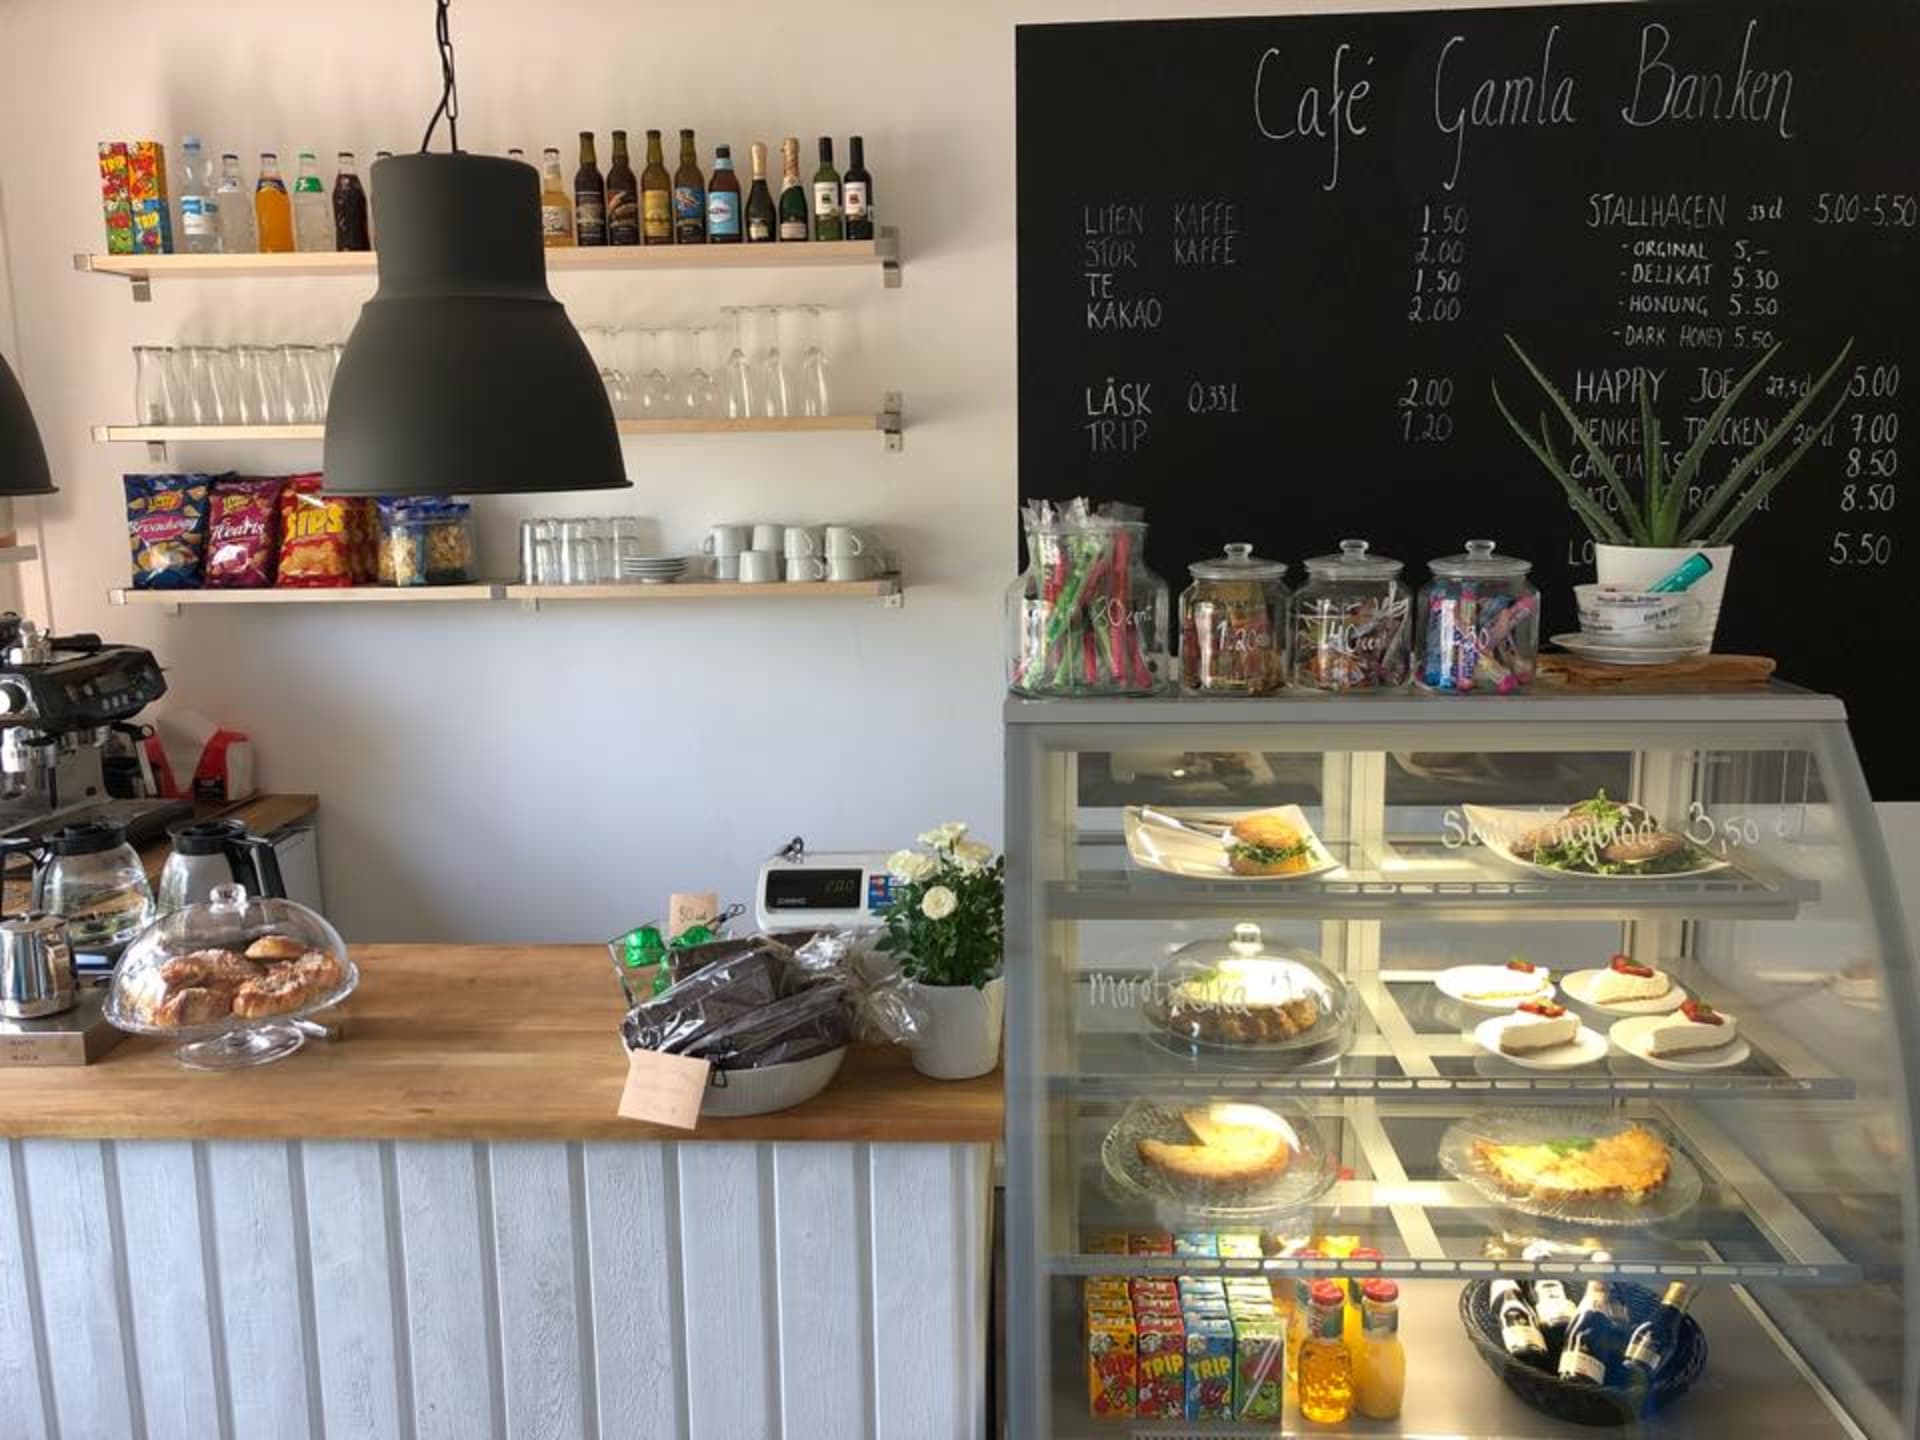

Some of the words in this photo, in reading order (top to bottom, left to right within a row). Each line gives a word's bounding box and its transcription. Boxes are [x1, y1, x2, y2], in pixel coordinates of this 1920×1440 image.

[1254, 44, 1376, 190] Café
[1435, 25, 1576, 190] Gamla
[1622, 19, 1794, 138] Banken
[1174, 202, 1239, 235] KAFFE
[1423, 204, 1468, 235] 1.50
[1085, 239, 1137, 267] STOR
[1174, 236, 1236, 265] KAFFE
[1415, 237, 1463, 265] 2.00
[1085, 273, 1114, 299] TE
[1415, 268, 1461, 294] 1.50
[1086, 298, 1162, 329] KAKAO
[1408, 296, 1461, 322] 2.00
[1728, 293, 1778, 316] 5.50
[1399, 377, 1453, 407] 2.00
[1574, 367, 1667, 404] HAPPY
[1691, 367, 1735, 402] JOE
[1850, 365, 1900, 398] 5.00
[1085, 420, 1147, 451] TRIP
[1403, 411, 1453, 441] 1.20
[1850, 412, 1898, 444] 7.00
[1846, 448, 1897, 478] 8.50
[1840, 484, 1895, 512] 8.50
[1829, 532, 1891, 566] 5.50
[1686, 801, 1760, 856] 3,50
[1141, 1353, 1184, 1379] TRIP
[1190, 1355, 1232, 1380] TRIP
